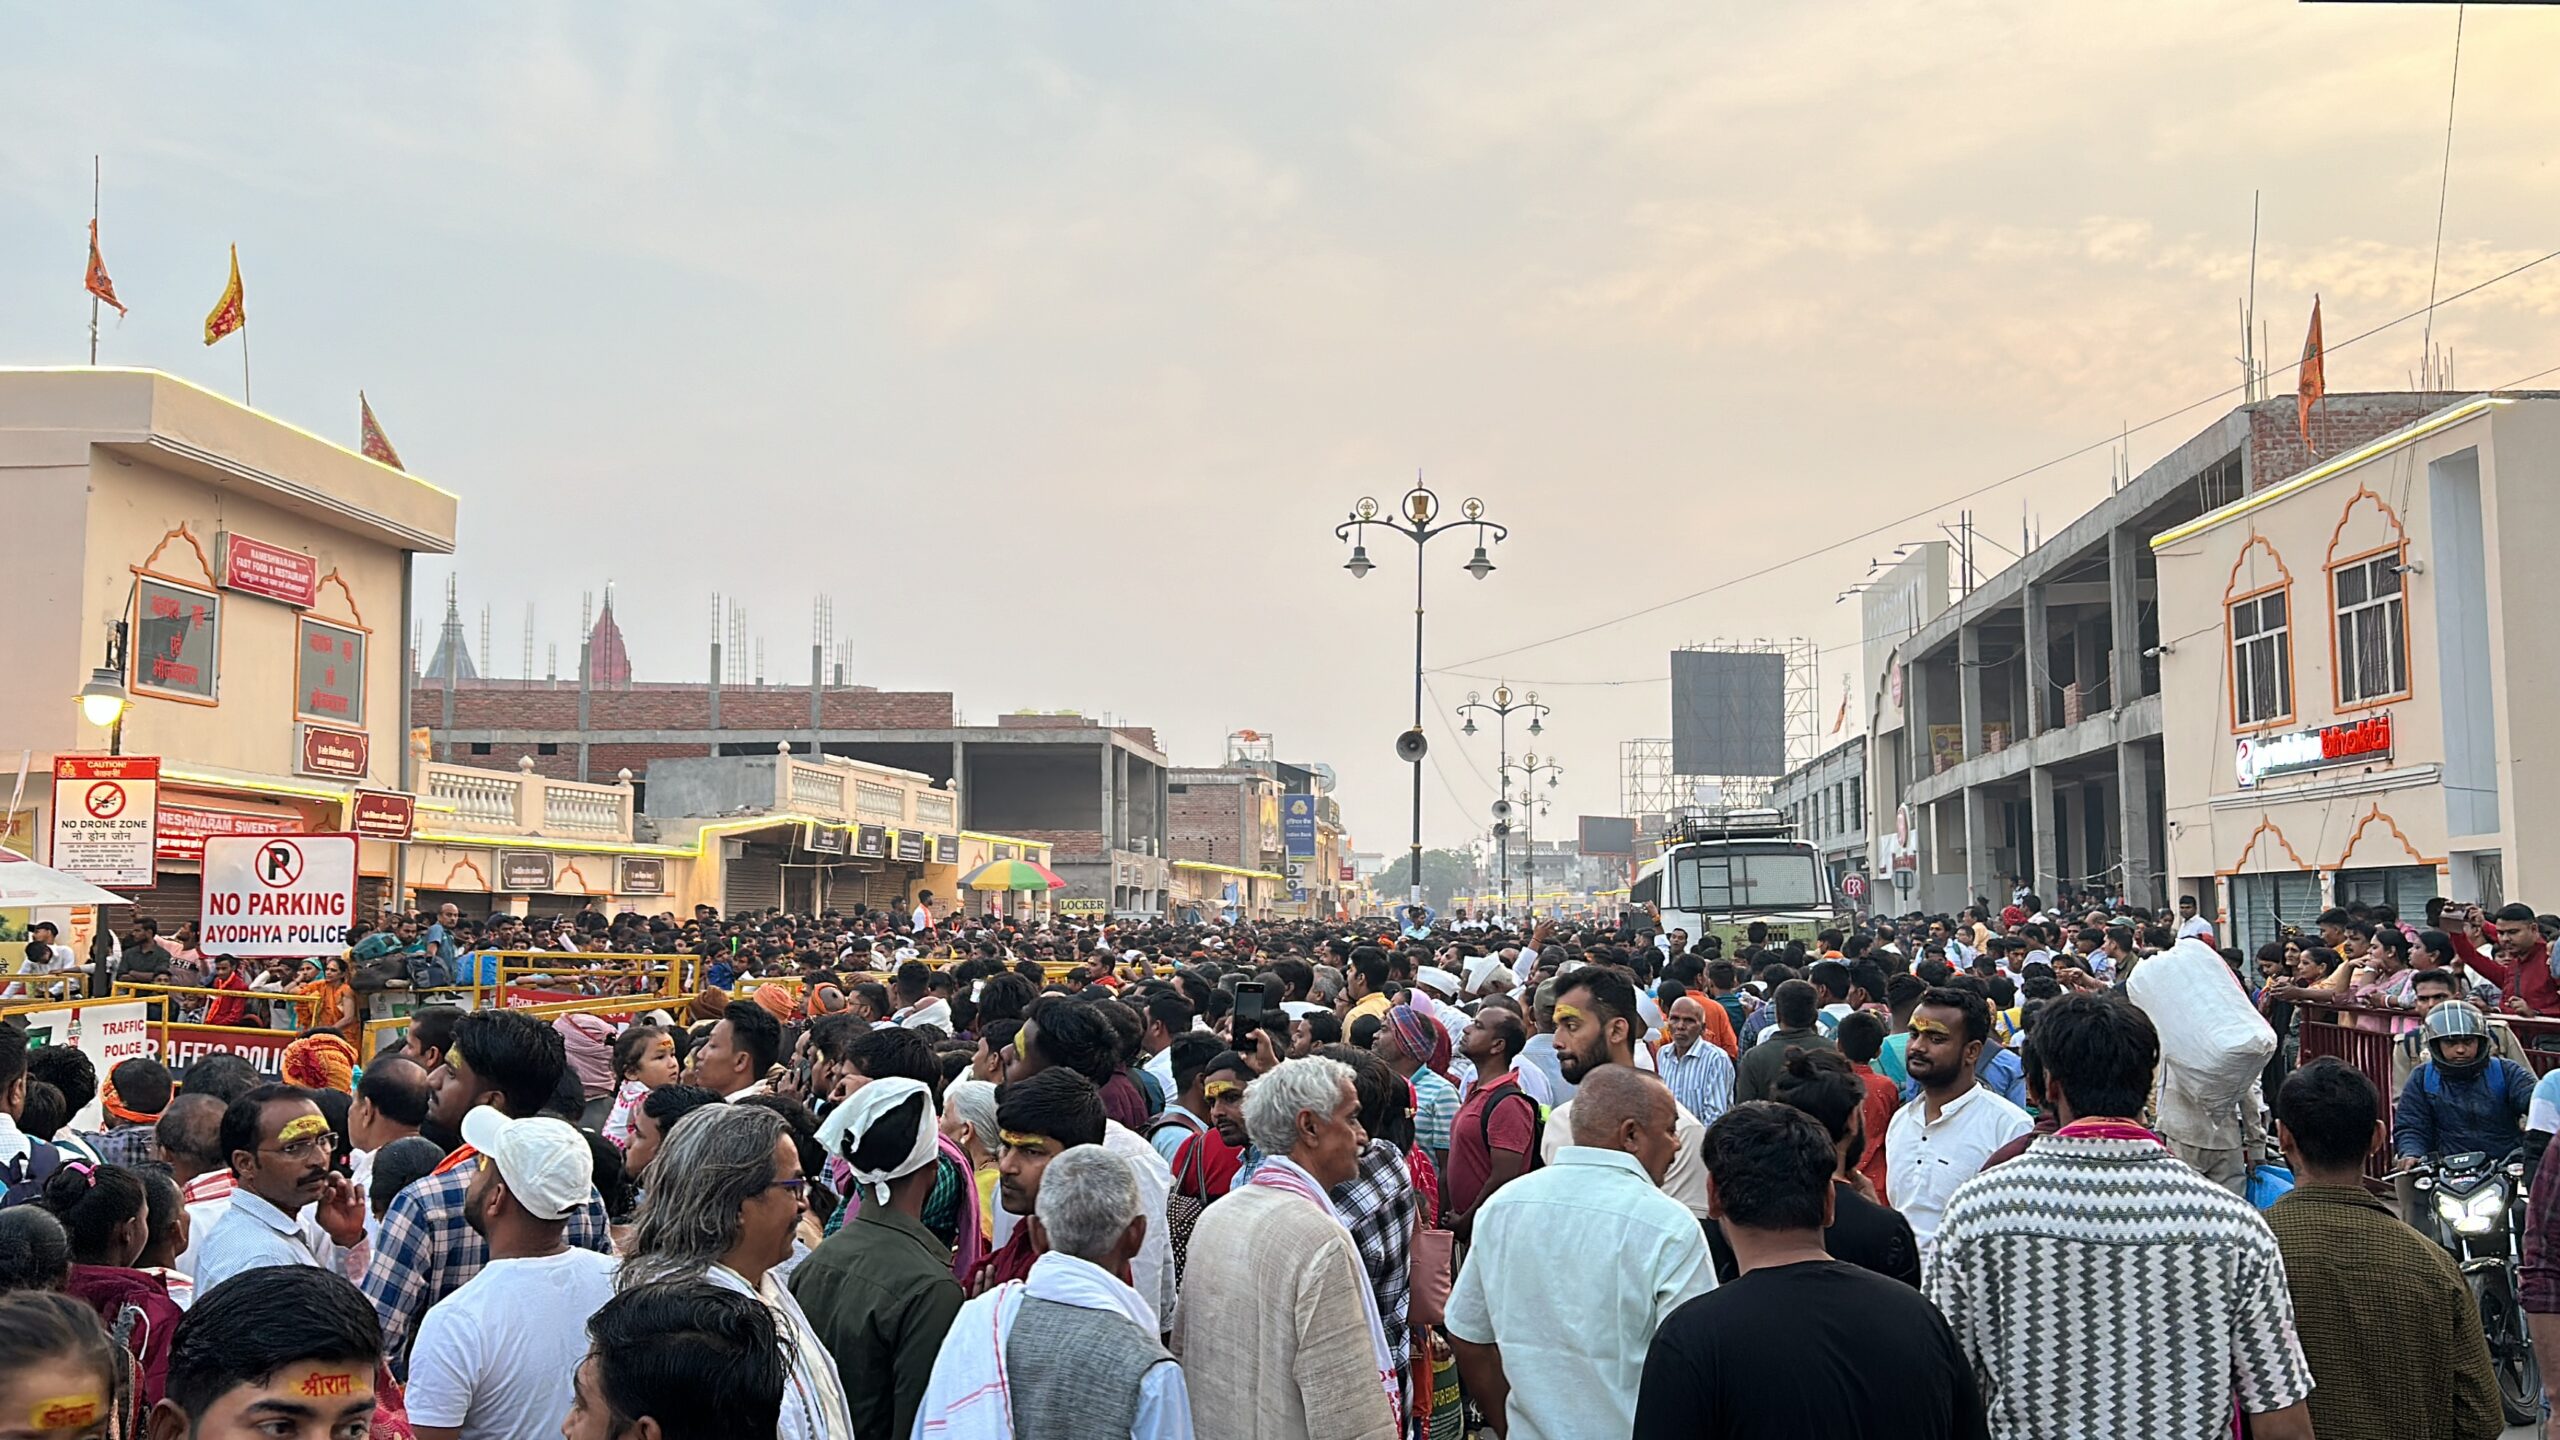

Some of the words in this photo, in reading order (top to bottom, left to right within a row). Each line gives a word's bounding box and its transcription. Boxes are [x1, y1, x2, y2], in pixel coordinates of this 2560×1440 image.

[236, 557, 251, 569] FAST
[252, 561, 268, 573] FOOD
[269, 565, 274, 575] &
[274, 567, 309, 583] RESTAURANT
[87, 761, 127, 769] CAUTION!
[61, 820, 78, 829] NO
[80, 820, 116, 829] DRONE
[119, 820, 148, 829] ZONE
[235, 821, 277, 833] SWEETS
[111, 830, 132, 841] जोन
[209, 892, 241, 916] NO
[247, 892, 345, 916] PARKING
[1060, 899, 1105, 910] LOCKER
[205, 925, 282, 943] AYODHYA
[287, 925, 348, 943] POLICE
[102, 1019, 145, 1035] TRAFFIC
[104, 1041, 142, 1057] POLICE
[300, 1373, 351, 1397] श्रीराम
